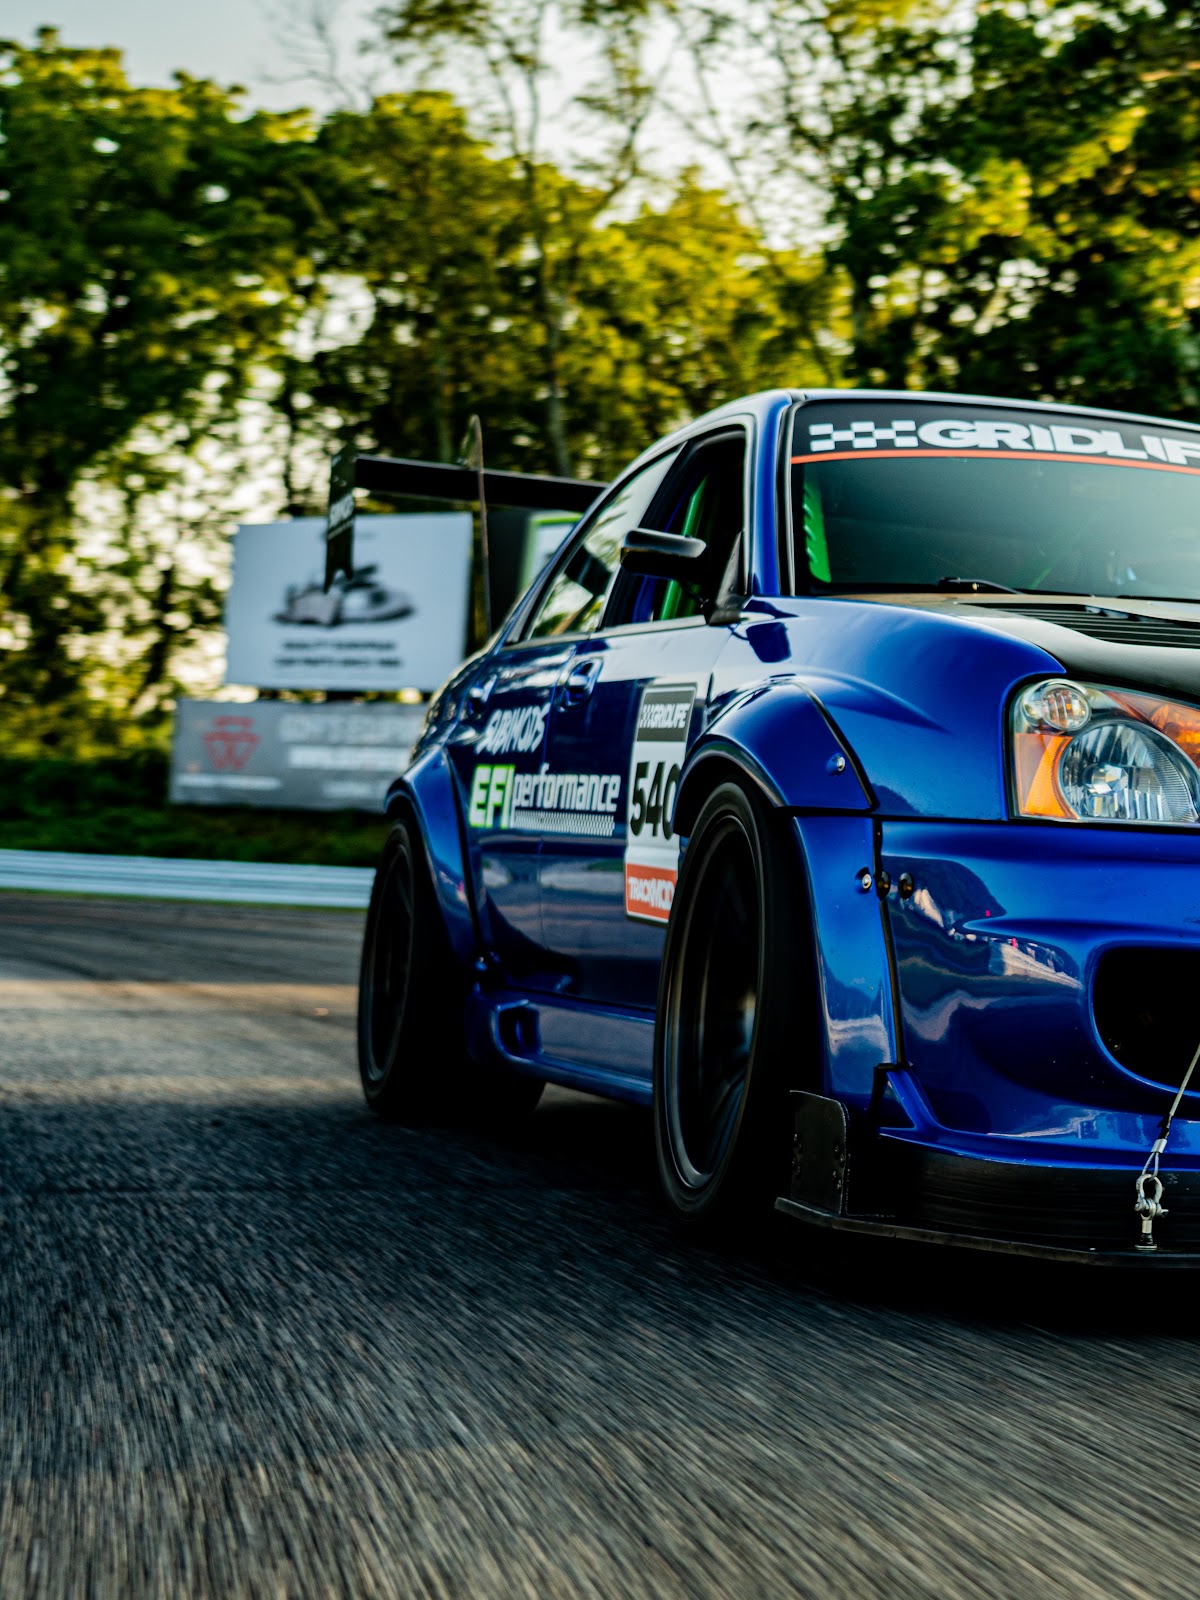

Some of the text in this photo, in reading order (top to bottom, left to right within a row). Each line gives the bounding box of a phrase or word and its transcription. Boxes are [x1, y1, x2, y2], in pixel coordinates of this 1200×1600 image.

[651, 702, 691, 729] GRIDLIFE
[469, 763, 621, 829] EFI performance
